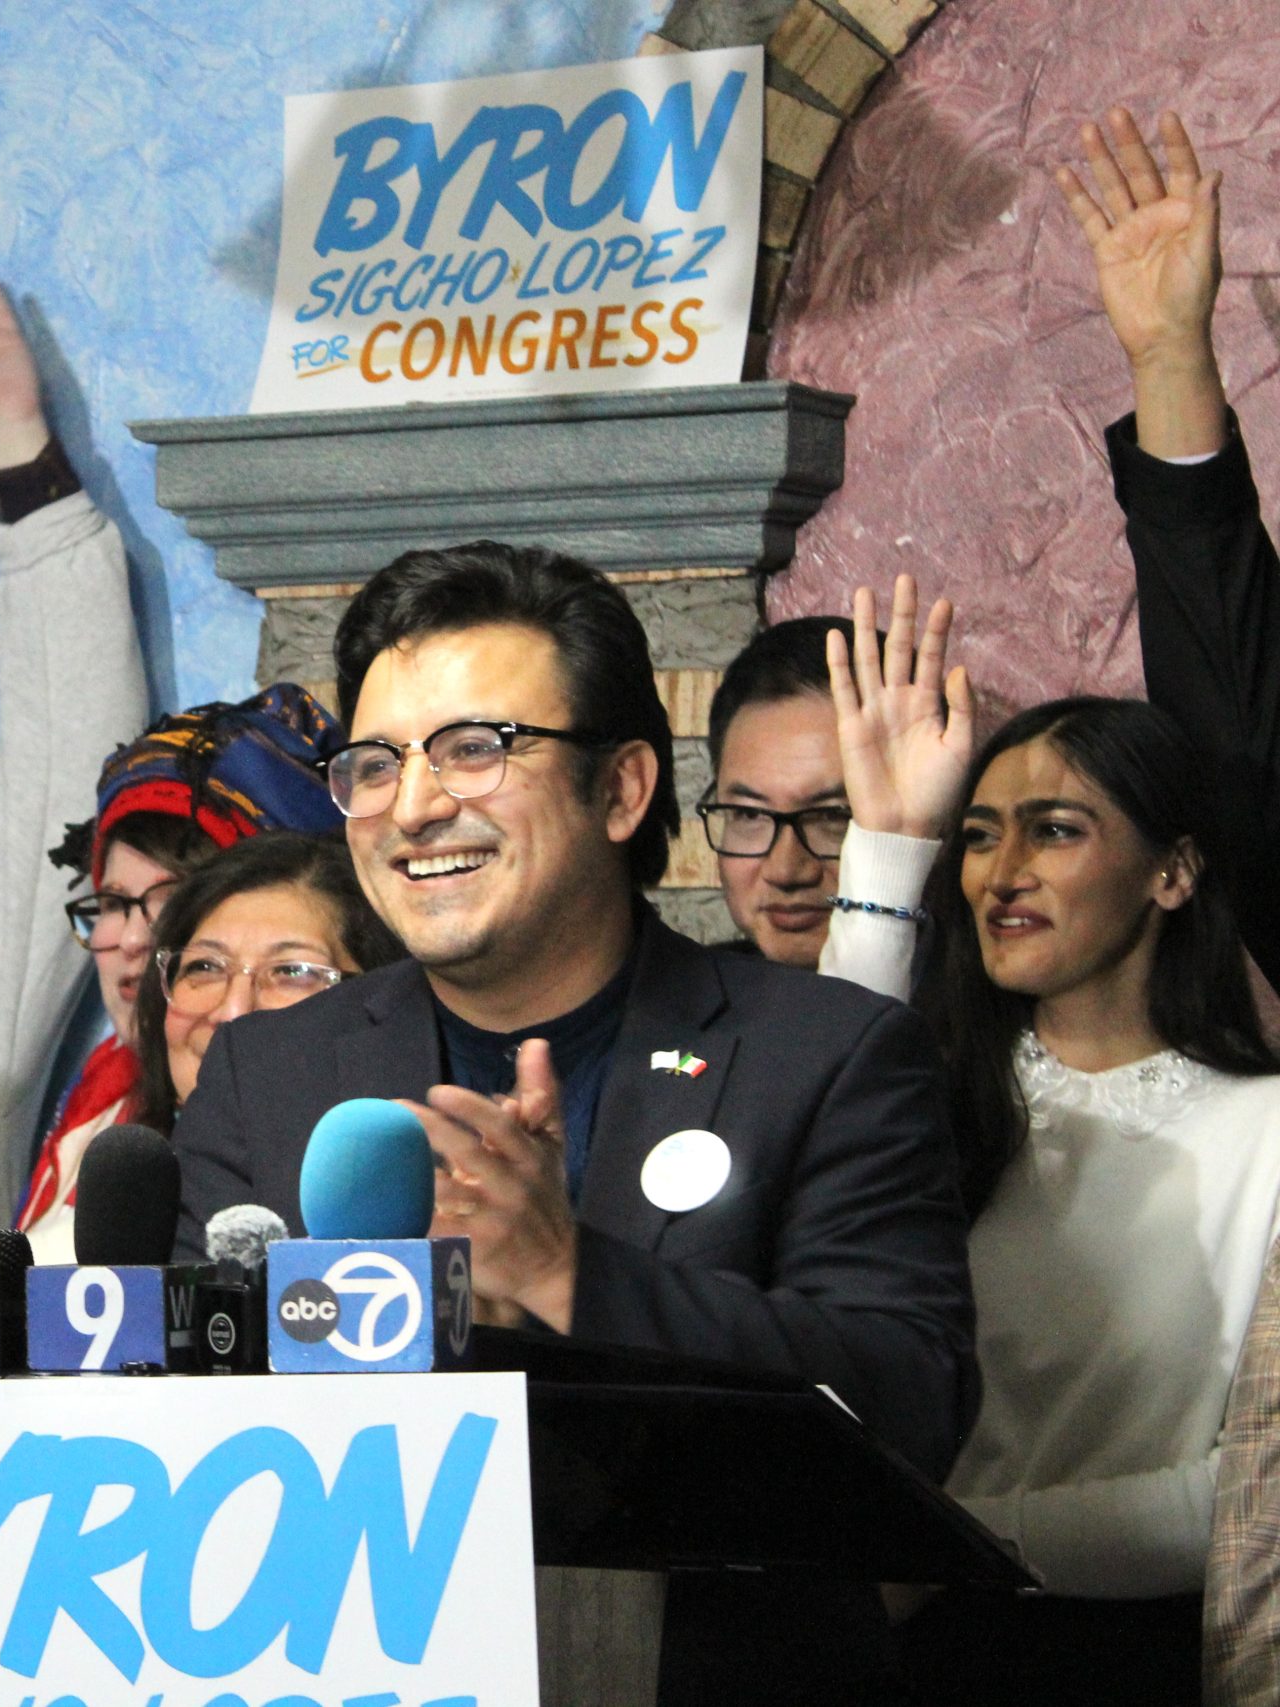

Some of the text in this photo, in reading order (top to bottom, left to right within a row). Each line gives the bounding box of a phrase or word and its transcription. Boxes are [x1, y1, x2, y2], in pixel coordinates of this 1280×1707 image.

[313, 70, 748, 259] BYRON
[295, 225, 726, 323] SIGCHO LOPEZ
[292, 298, 705, 383] FOR CONGRESS
[65, 1266, 125, 1370] 9
[280, 1251, 423, 1362] abc 7
